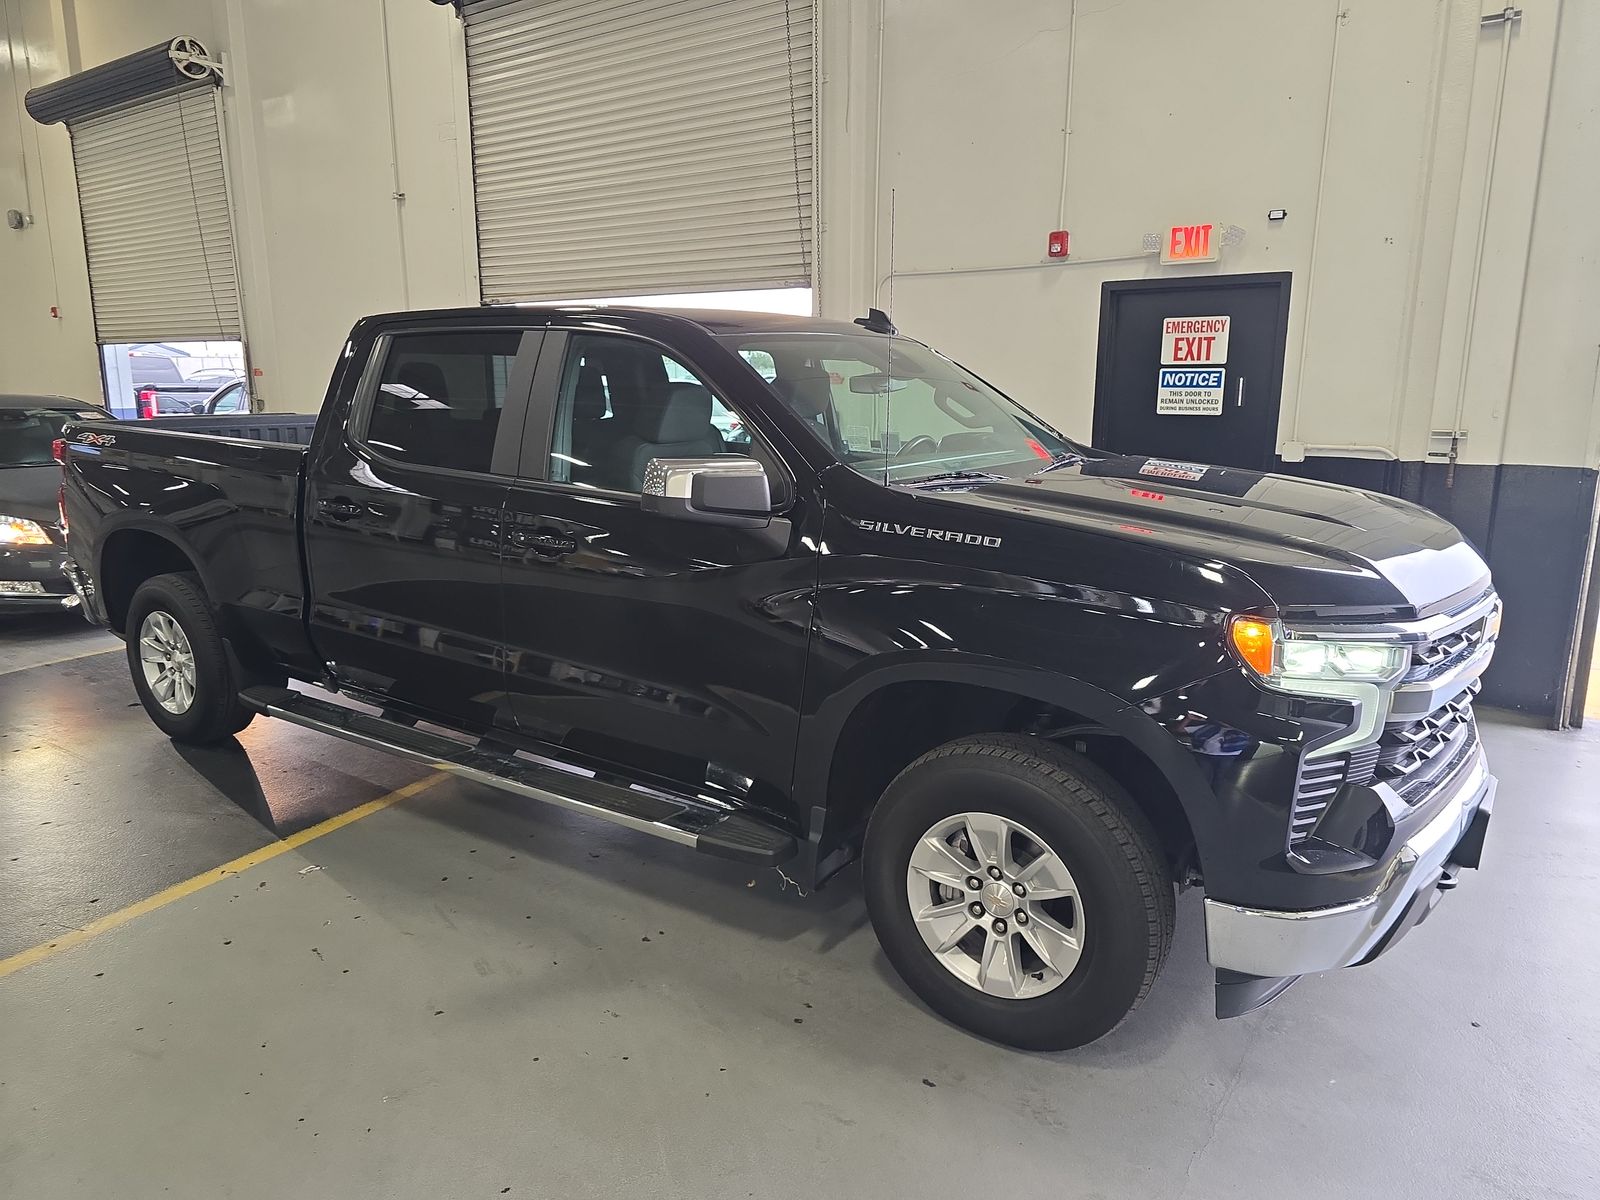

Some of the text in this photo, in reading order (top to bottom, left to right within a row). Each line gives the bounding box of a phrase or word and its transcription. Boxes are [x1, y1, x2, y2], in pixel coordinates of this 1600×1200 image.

[1169, 224, 1212, 258] EXIT
[1165, 319, 1227, 334] EMERGENCY
[1173, 336, 1216, 361] EXIT
[1163, 372, 1220, 386] NOTICE
[858, 519, 1002, 548] SILVERADO
